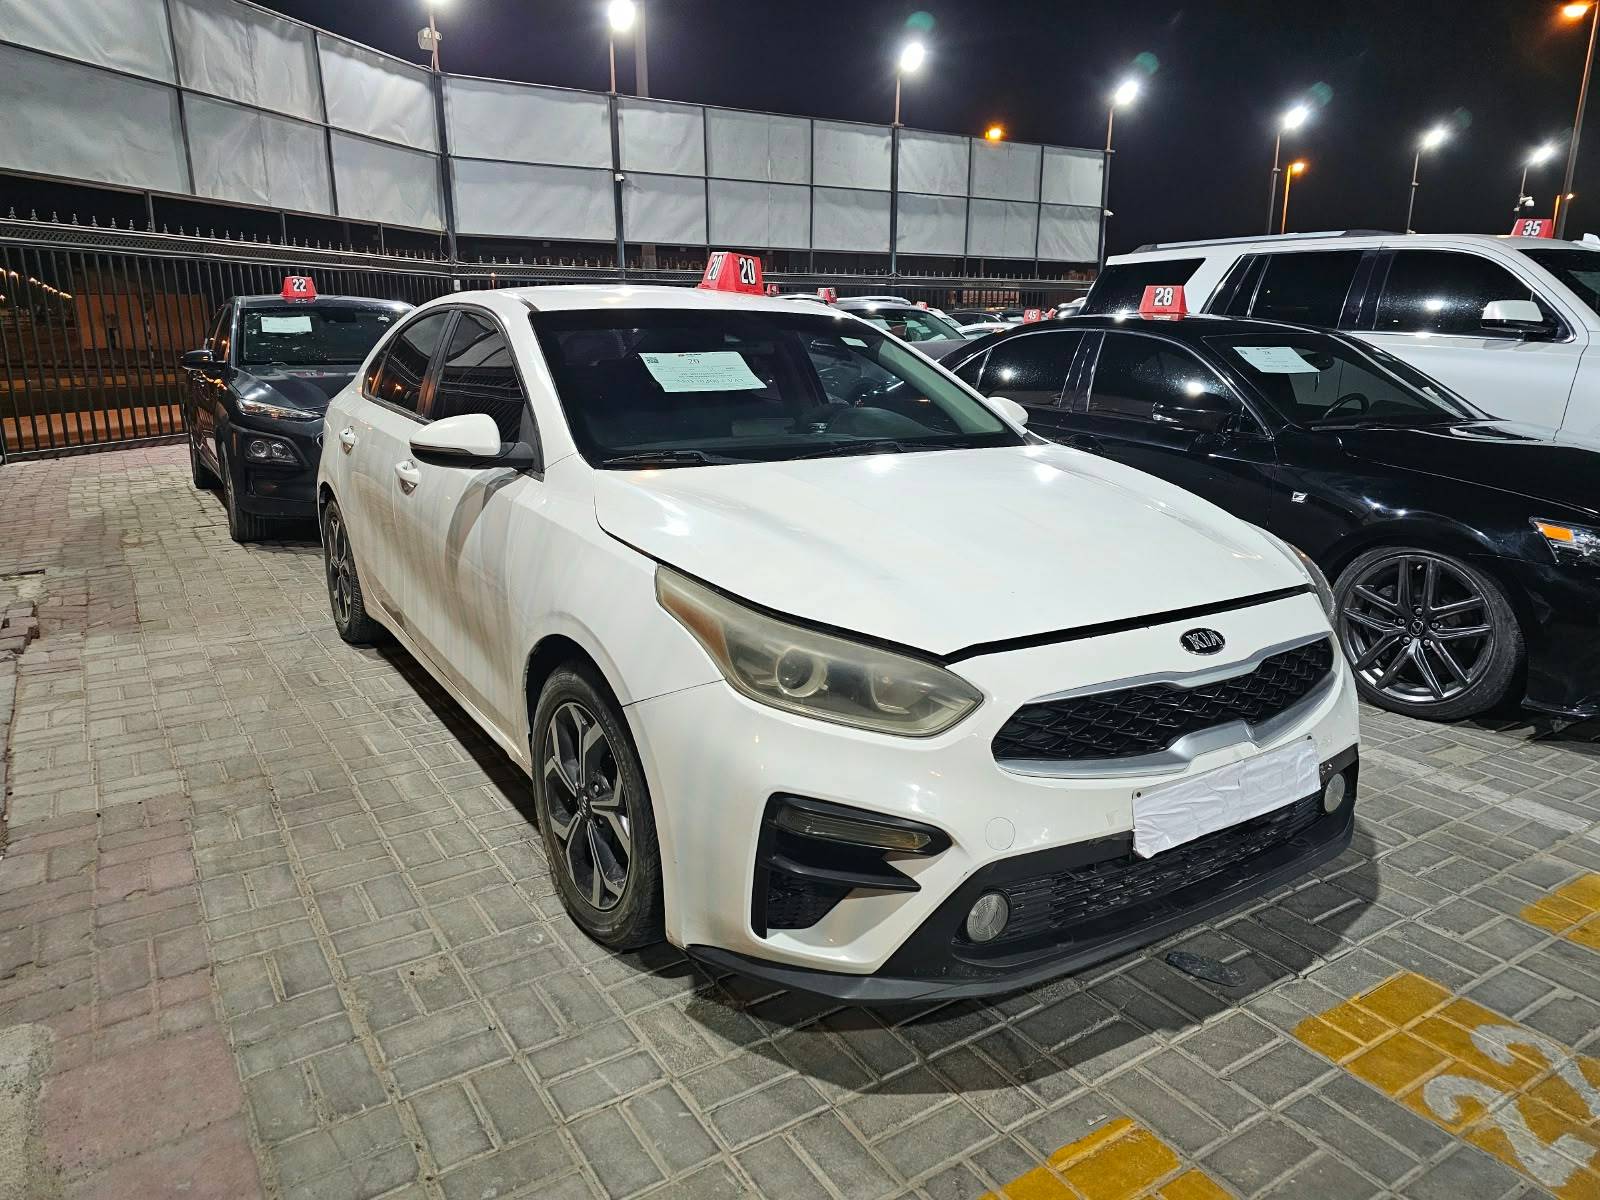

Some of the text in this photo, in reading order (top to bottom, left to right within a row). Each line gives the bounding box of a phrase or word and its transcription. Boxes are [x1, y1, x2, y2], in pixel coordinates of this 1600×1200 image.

[1523, 220, 1542, 236] 35
[707, 254, 723, 280] 20
[739, 257, 756, 285] 20
[292, 278, 307, 292] 22
[1153, 287, 1174, 306] 28
[1186, 630, 1223, 650] KIA
